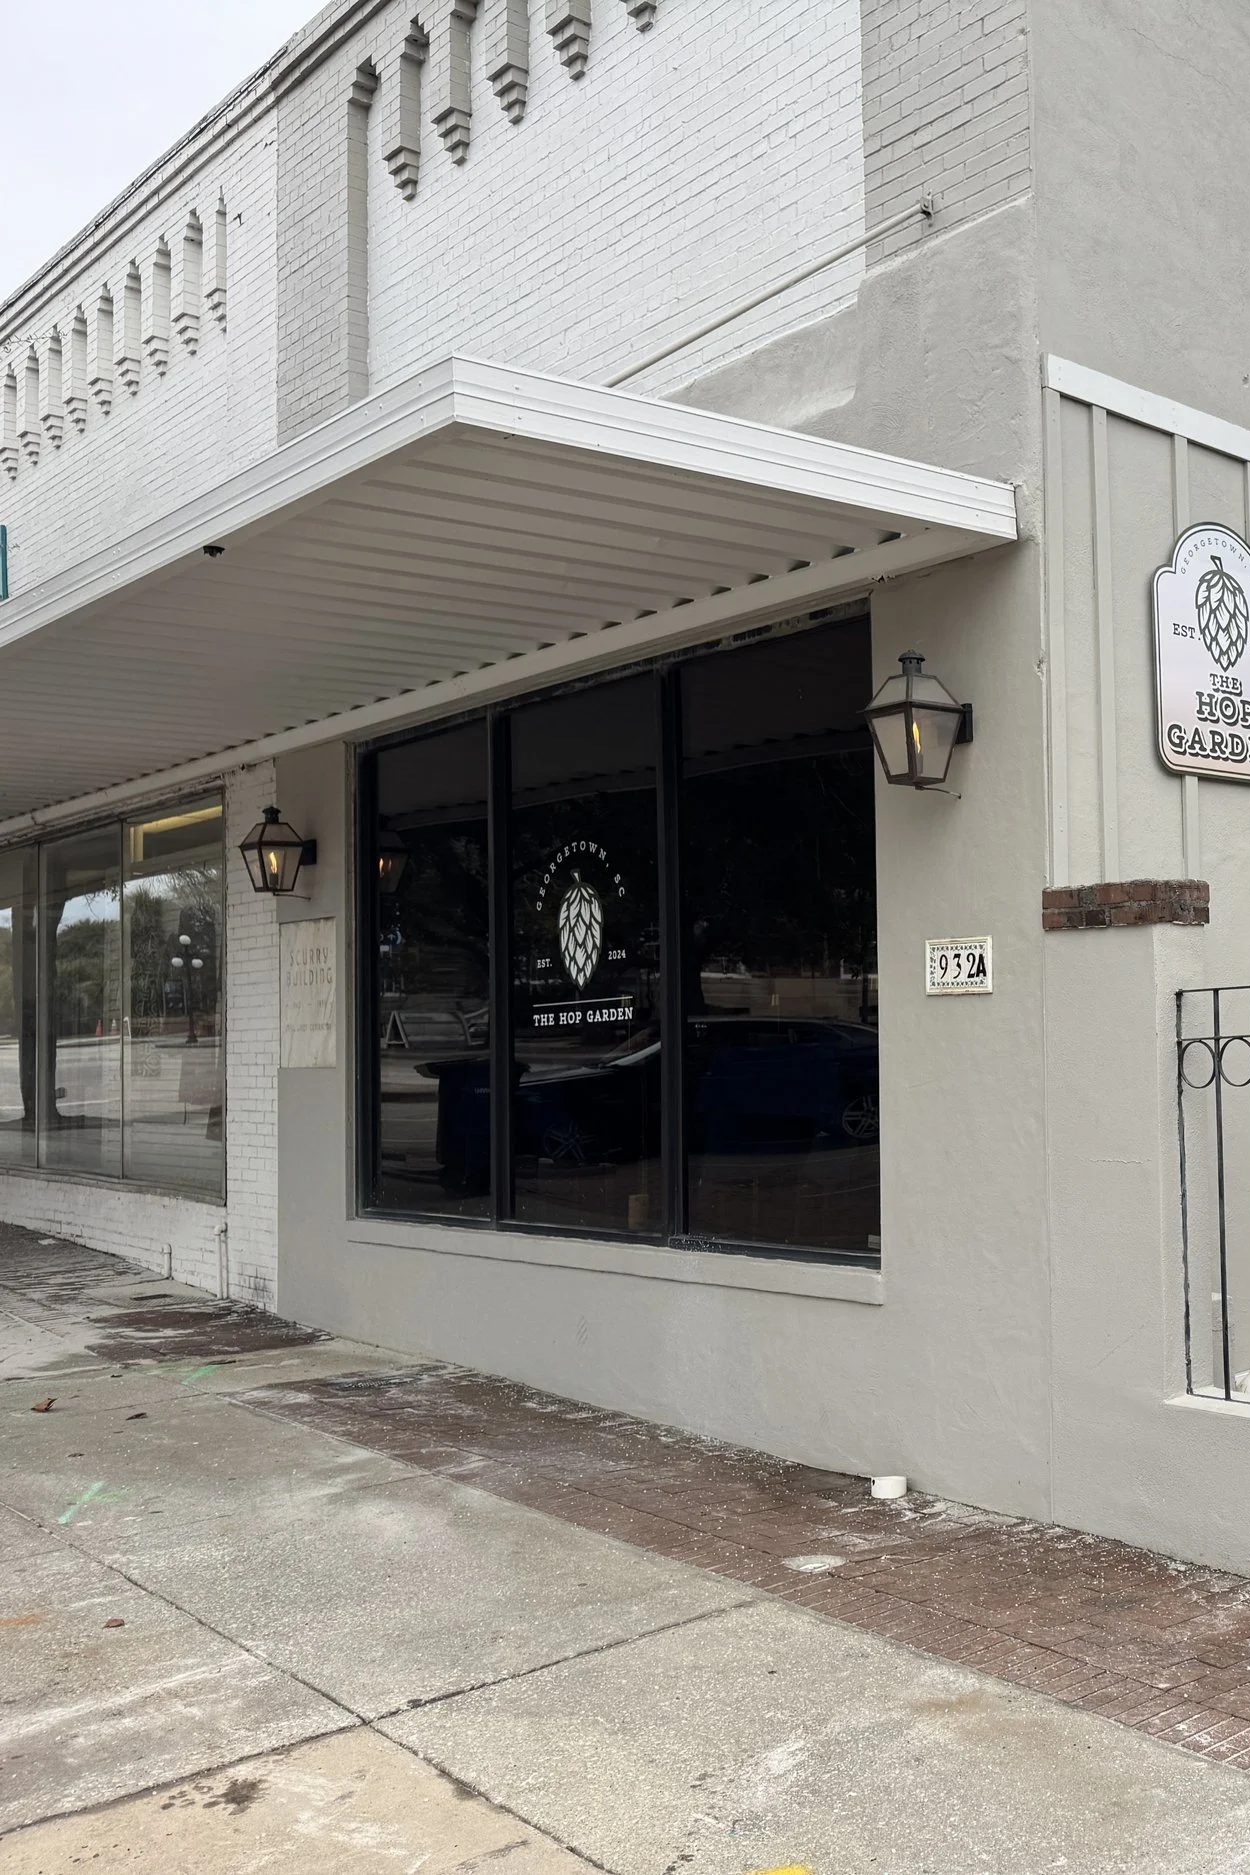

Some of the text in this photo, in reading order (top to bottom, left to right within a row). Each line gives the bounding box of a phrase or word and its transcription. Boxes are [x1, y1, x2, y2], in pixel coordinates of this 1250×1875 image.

[1209, 673, 1242, 695] THE
[536, 841, 625, 911] GEORGETOWN, SC
[537, 959, 553, 969] EST.
[608, 949, 626, 960] 2024
[939, 952, 987, 980] 932A
[533, 1007, 633, 1027] THE HOP GARDEN
